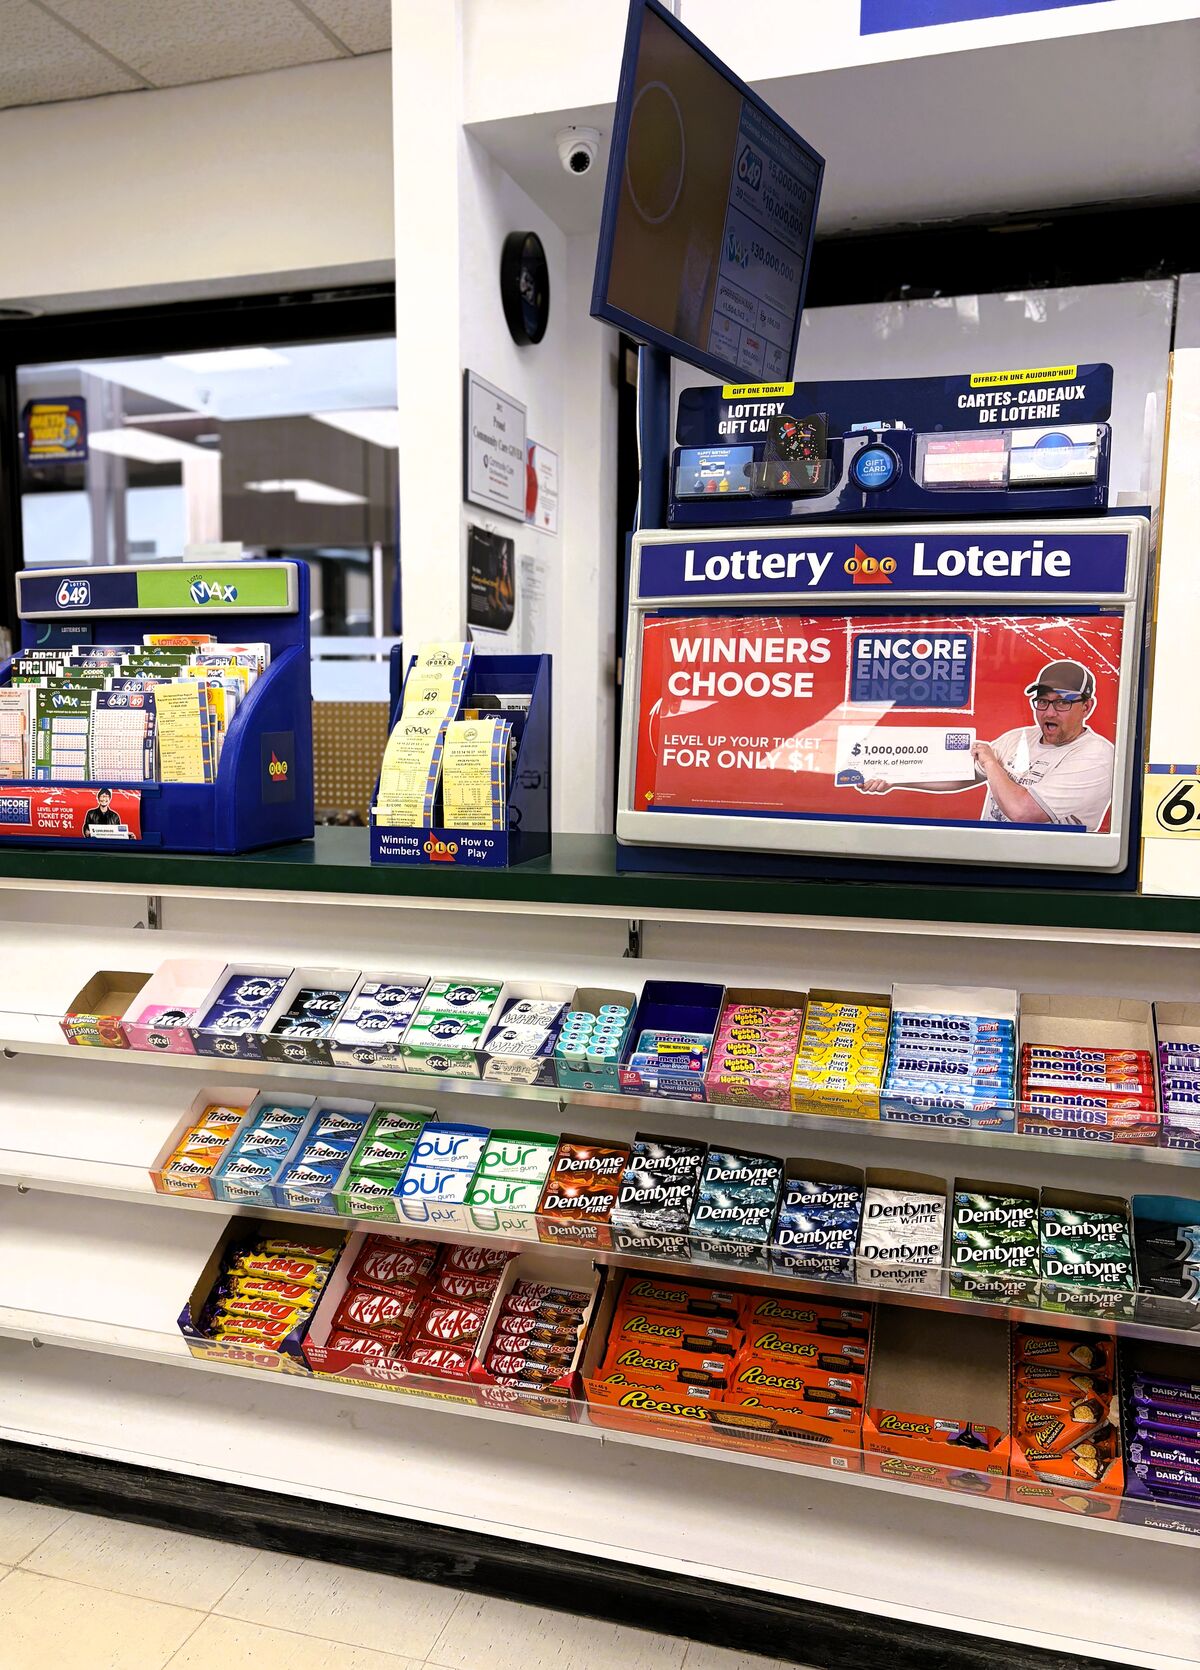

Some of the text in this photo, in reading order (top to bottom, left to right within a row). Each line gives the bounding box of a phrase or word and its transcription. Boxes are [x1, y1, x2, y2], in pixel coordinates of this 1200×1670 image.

[762, 189, 803, 233] $10,000,000
[751, 240, 794, 282] $30,000,000
[974, 368, 1075, 384] OFFREZ-EN UNE AUJOURD'HUI!
[732, 386, 785, 395] GIFT ONE TODAY!
[957, 386, 1086, 409] CARTES-CADEAUX
[728, 402, 785, 419] LOTTERY
[979, 403, 1061, 423] DE LOTERIE
[718, 418, 742, 435] GIFT
[863, 465, 886, 473] CARD
[865, 459, 884, 467] GIFT
[684, 540, 1072, 585] Lottery OLG Loterie
[57, 581, 88, 607] 649
[668, 636, 832, 664] WINNERS
[857, 638, 968, 660] ENCORE
[429, 658, 453, 666] POKER
[856, 658, 968, 681] ENCORE
[667, 669, 814, 700] CHOOSE
[108, 695, 142, 707] 649 49
[423, 691, 438, 701] 49
[663, 734, 821, 750] LEVEL UP YOUR TICKET
[851, 743, 928, 756] $ 1,000,000.00
[662, 748, 821, 773] FOR ONLY $1.
[38, 820, 74, 829] ONLY $1.
[381, 835, 494, 848] Winning How to
[379, 841, 488, 860] Numbers OLG Play
[375, 990, 411, 1002] excel
[445, 990, 481, 1002] excel
[357, 1018, 395, 1030] excel
[430, 1024, 466, 1036] excel
[902, 1017, 999, 1032] mentos mint
[148, 1036, 170, 1045] excel
[737, 1033, 761, 1041] Bubba
[216, 1042, 238, 1051] excel
[284, 1048, 308, 1056] excel
[1031, 1048, 1106, 1062] mentos
[897, 1058, 969, 1075] mentos
[1030, 1059, 1106, 1074] mentos
[677, 1085, 700, 1093] Breath
[262, 1111, 304, 1124] Trident
[320, 1117, 363, 1130] Trident
[377, 1117, 421, 1130] Trident
[886, 1109, 970, 1127] mentos
[1023, 1123, 1115, 1141] mentos
[187, 1133, 230, 1146] Trident
[243, 1133, 287, 1146] Trident
[304, 1145, 349, 1159] Trident
[363, 1146, 408, 1160] Trident
[451, 1154, 468, 1162] gum
[170, 1161, 212, 1175] Trident
[556, 1156, 624, 1173] Dentyne
[630, 1154, 701, 1171] Dentyne
[597, 1166, 618, 1176] FIRE
[673, 1165, 691, 1175] ICE
[706, 1166, 778, 1182] Dentyne
[750, 1178, 768, 1187] ICE
[620, 1183, 691, 1203] Dentyne
[787, 1190, 859, 1206] Dentyne
[543, 1194, 614, 1210] Dentyne
[663, 1197, 681, 1207] ICE
[585, 1205, 607, 1214] FIRE
[695, 1204, 771, 1220] Dentyne
[741, 1216, 760, 1226] ICE
[901, 1214, 937, 1225] WHITE
[548, 1225, 598, 1238] Dentyne
[618, 1234, 685, 1249] Dentyne
[663, 1244, 679, 1253] ICE
[700, 1241, 755, 1254] Dentyne
[1175, 1226, 1193, 1260] 5
[736, 1250, 750, 1258] ICE
[521, 1284, 550, 1299] KitKat
[351, 1296, 401, 1324] KitKat
[509, 1298, 541, 1313] KitKat
[427, 1309, 480, 1338] KitKat
[503, 1319, 536, 1333] KitKat
[623, 1315, 684, 1338] Reese's
[530, 1340, 575, 1354] CHUNKY Rolo
[754, 1333, 819, 1357] Reese's
[617, 1349, 680, 1372] Reese's
[739, 1366, 804, 1391] Reese's
[1180, 1390, 1200, 1400] MILK
[619, 1391, 709, 1420] Reese's
[880, 1414, 932, 1434] Reese's
[1150, 1450, 1177, 1461] DAIRY
[1156, 1471, 1184, 1482] DAIRY
